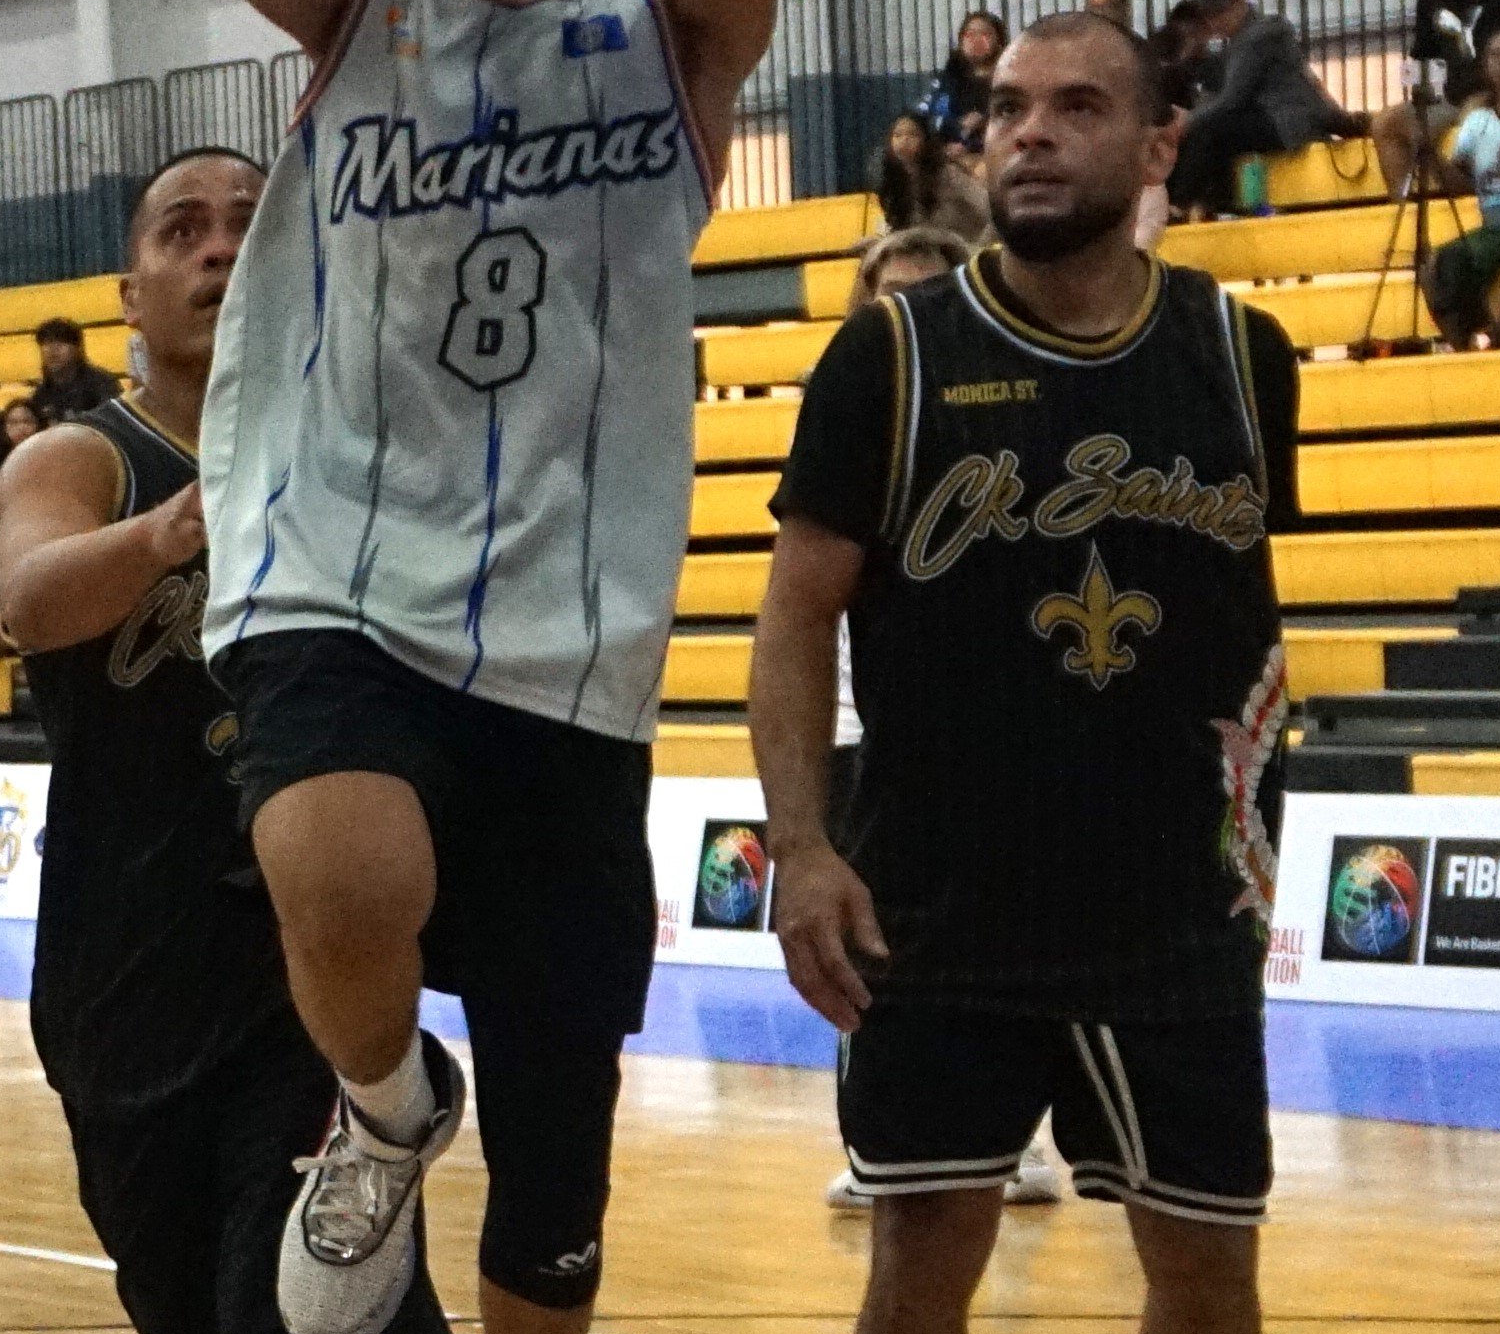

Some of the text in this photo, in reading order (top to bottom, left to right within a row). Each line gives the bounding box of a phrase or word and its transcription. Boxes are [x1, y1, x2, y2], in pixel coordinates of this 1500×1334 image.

[331, 108, 683, 223] Marianas
[437, 225, 548, 393] 8
[942, 381, 1012, 404] MONICA
[1034, 433, 1266, 551] Saints
